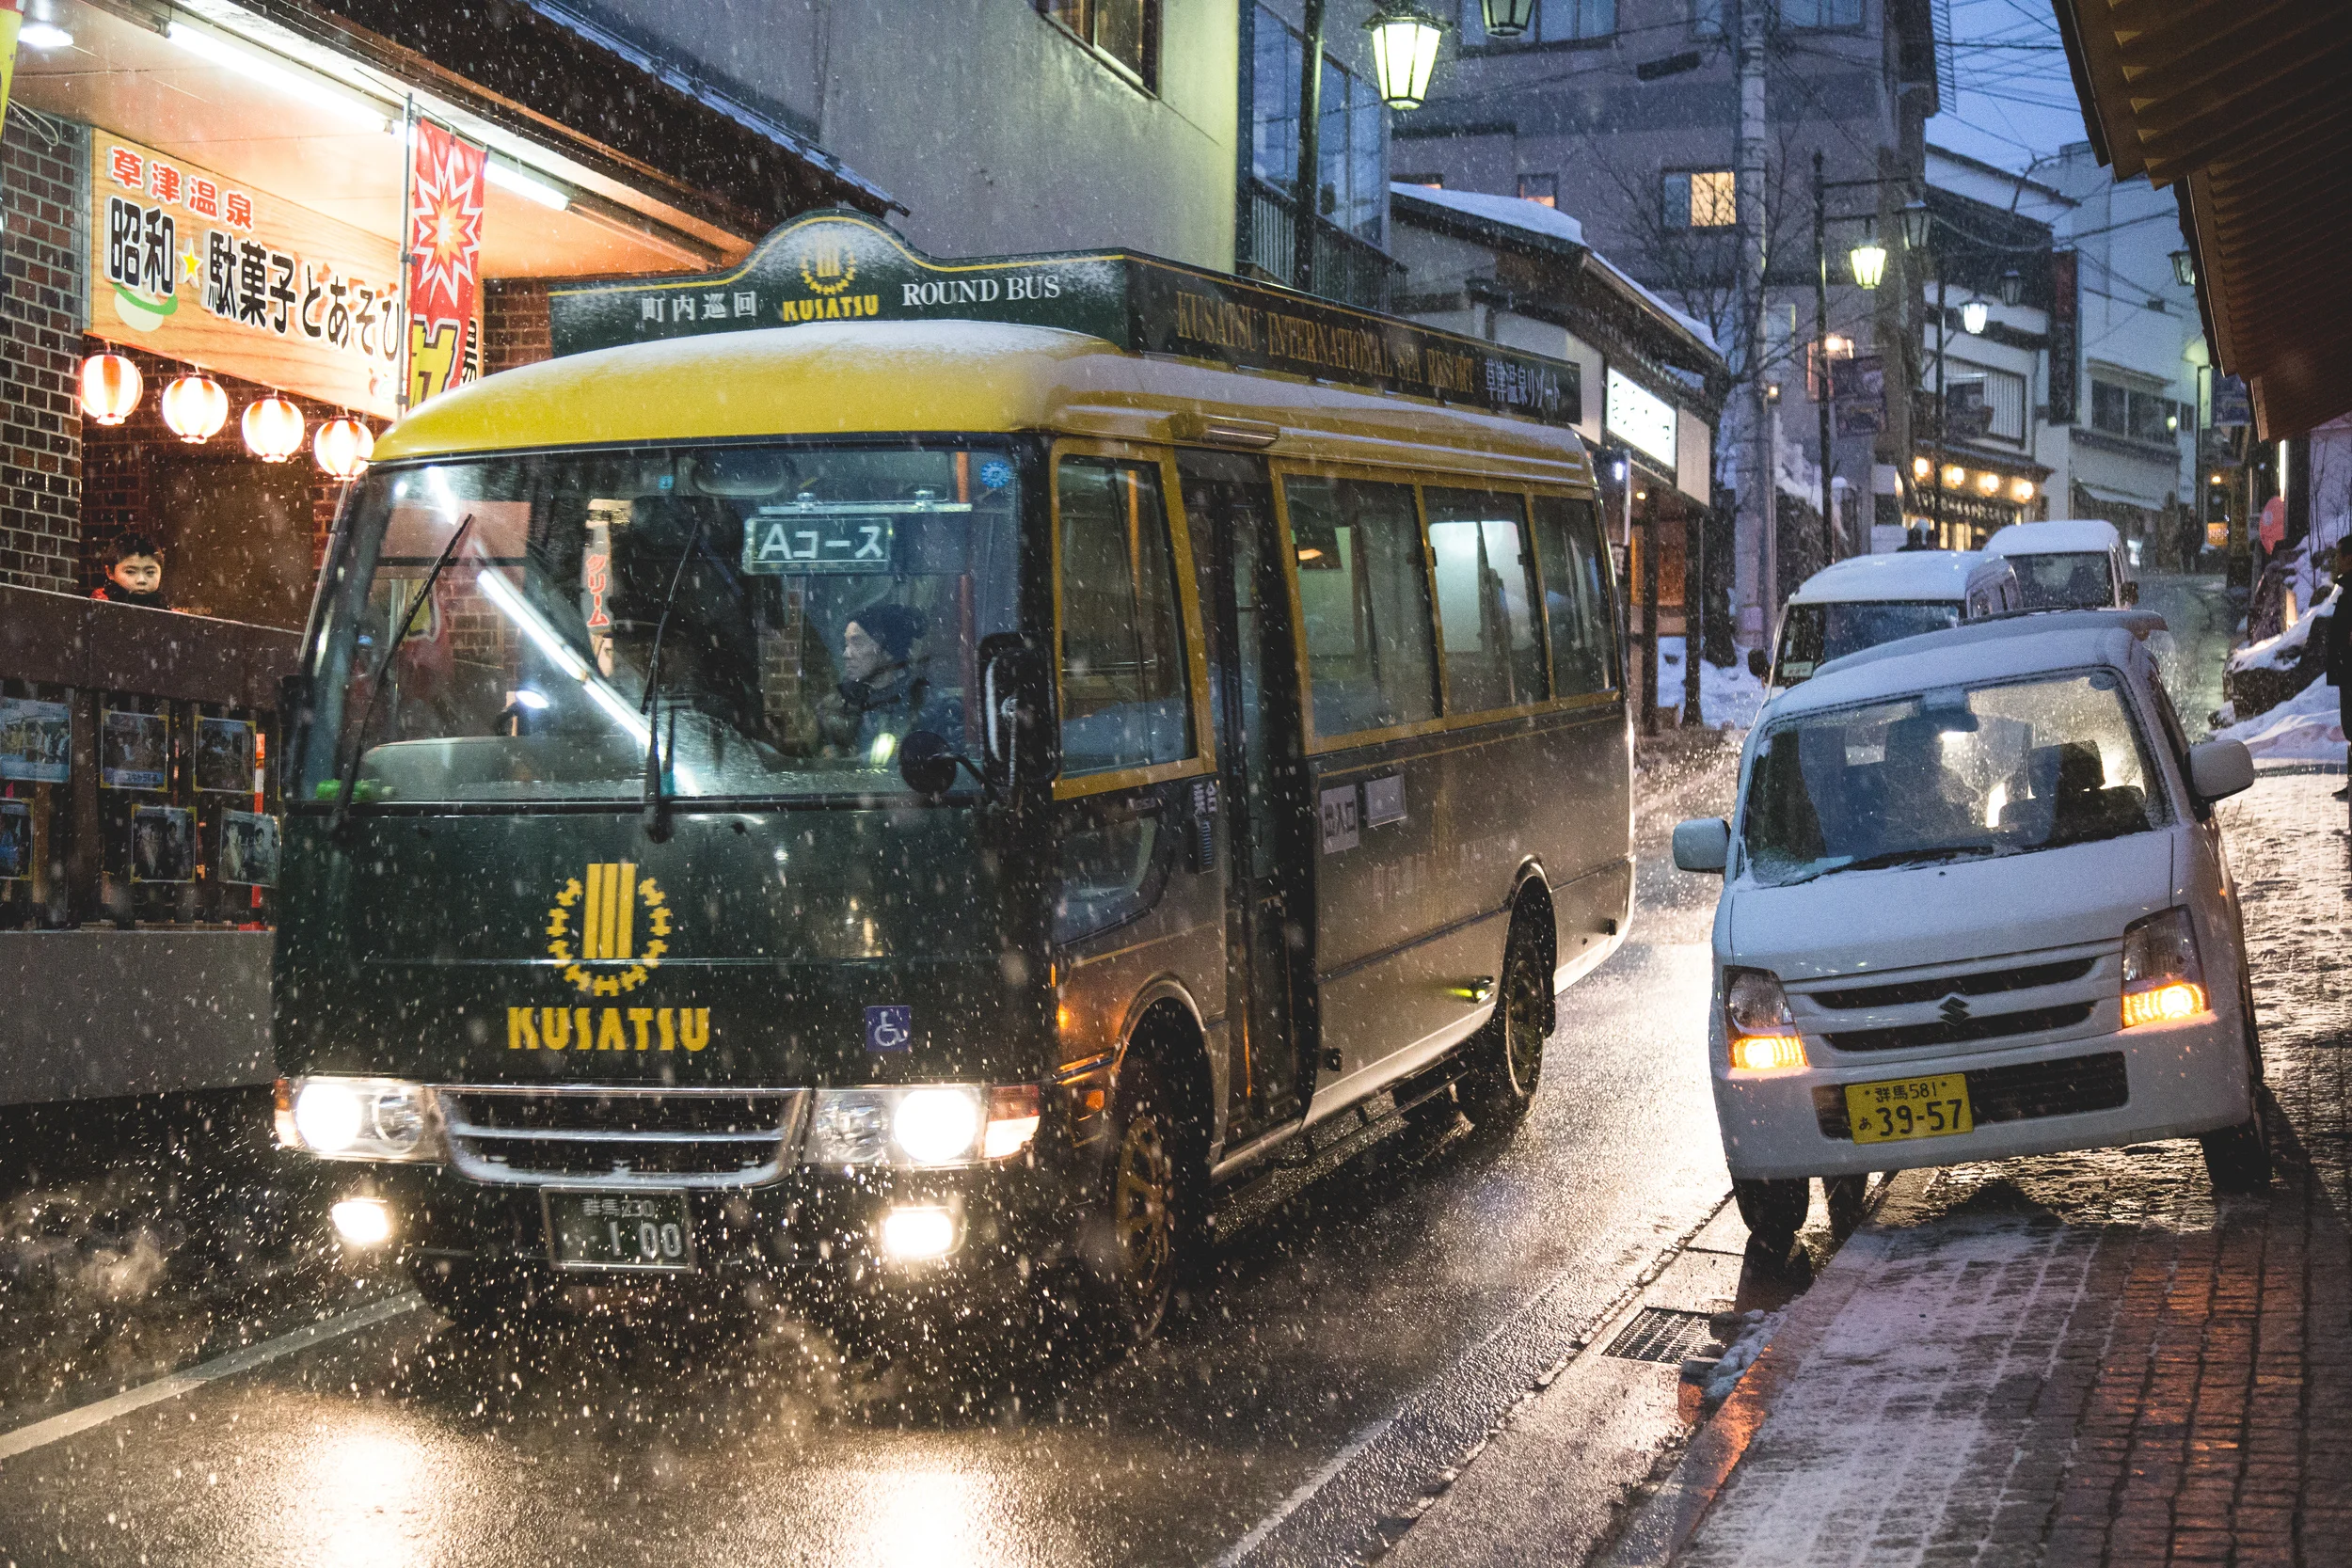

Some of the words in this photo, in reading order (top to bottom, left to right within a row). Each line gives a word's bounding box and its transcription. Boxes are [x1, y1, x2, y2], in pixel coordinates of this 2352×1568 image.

[112, 148, 252, 230] 草津温泉
[641, 291, 757, 323] 町内巡回
[782, 293, 880, 323] KUSATSU
[901, 278, 999, 307] ROUND
[1005, 275, 1061, 301] BUS
[1176, 291, 1259, 352] KUSATSU
[1266, 311, 1393, 377] INTERNATIONAL
[1426, 348, 1474, 394] RESORT
[756, 523, 884, 560] Aコース
[507, 1006, 711, 1052] KUSATSU
[1874, 1081, 1938, 1103] 群馬581
[1875, 1098, 1963, 1137] 39-57
